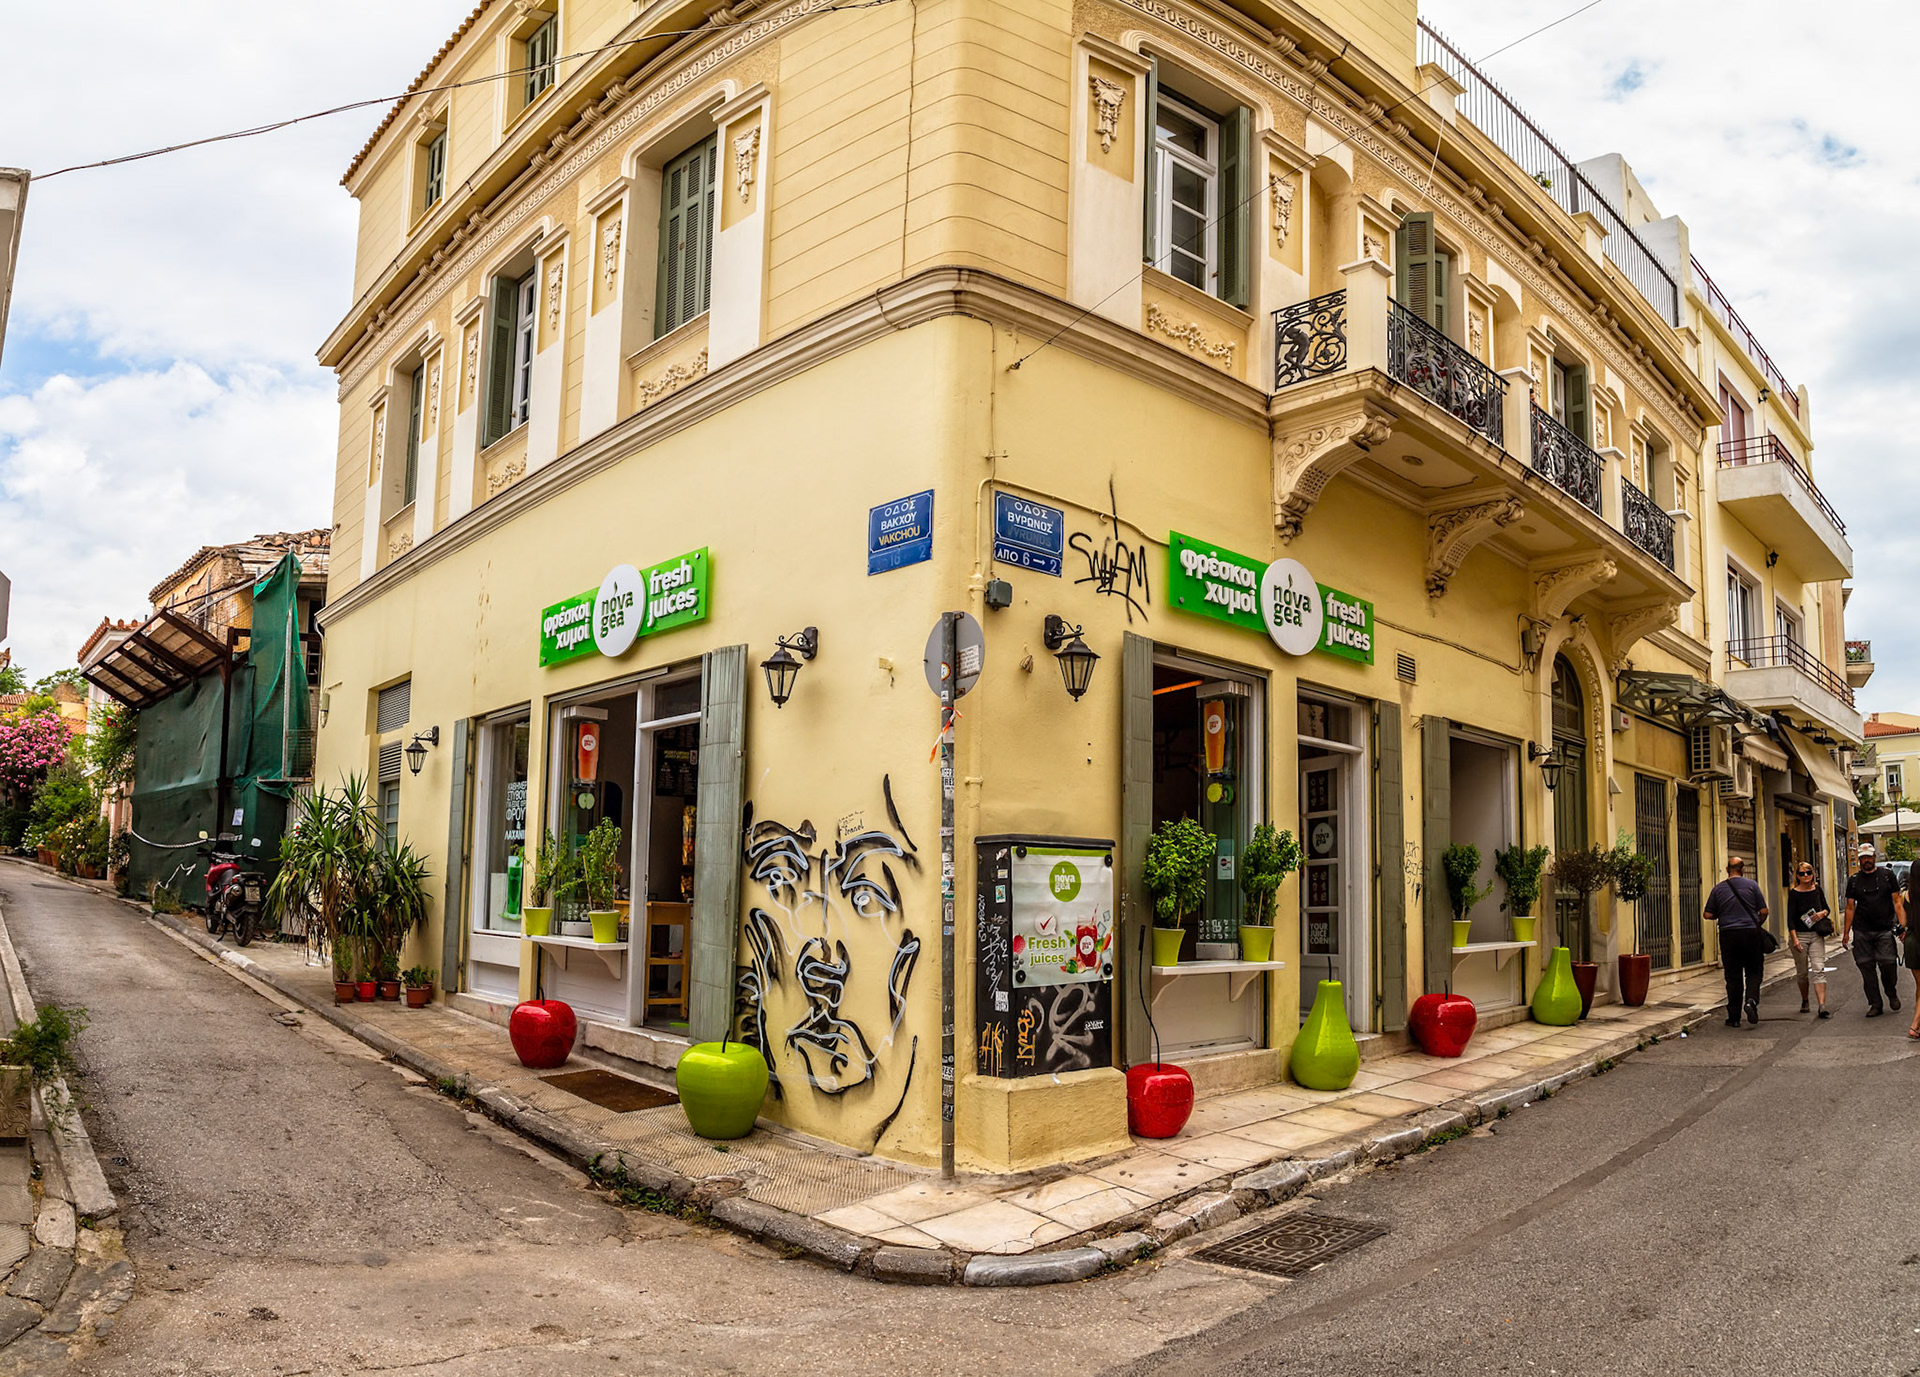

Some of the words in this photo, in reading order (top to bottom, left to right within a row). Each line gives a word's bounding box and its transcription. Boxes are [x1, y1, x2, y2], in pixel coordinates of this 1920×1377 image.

[880, 511, 917, 531] ΒΑΚΧΟΥ
[884, 500, 916, 517] ΟΔΟΣ
[1014, 501, 1048, 519] ΟΔΟΣ
[878, 525, 920, 546] VAKCHOU
[1007, 511, 1053, 534] ΒΥΡΩΝΟΣ
[997, 548, 1019, 562] ΑΠΟ
[1022, 552, 1031, 566] 6
[1050, 560, 1057, 573] 2
[1180, 549, 1257, 590] φρέσκοι
[650, 559, 693, 595] fresh
[601, 590, 634, 616] nova
[647, 587, 699, 628] juices
[1204, 580, 1257, 615] χυμοί
[1273, 584, 1312, 613] nova
[1326, 592, 1365, 627] fresh
[543, 601, 592, 638] φρέσκοι
[600, 609, 625, 639] gea
[1273, 602, 1303, 628] gea
[555, 618, 591, 651] χυμοί
[1326, 621, 1371, 651] juices
[1055, 882, 1071, 893] gea
[1310, 922, 1328, 930] YOUR
[1028, 936, 1066, 949] Fresh
[1030, 953, 1065, 967] juices
